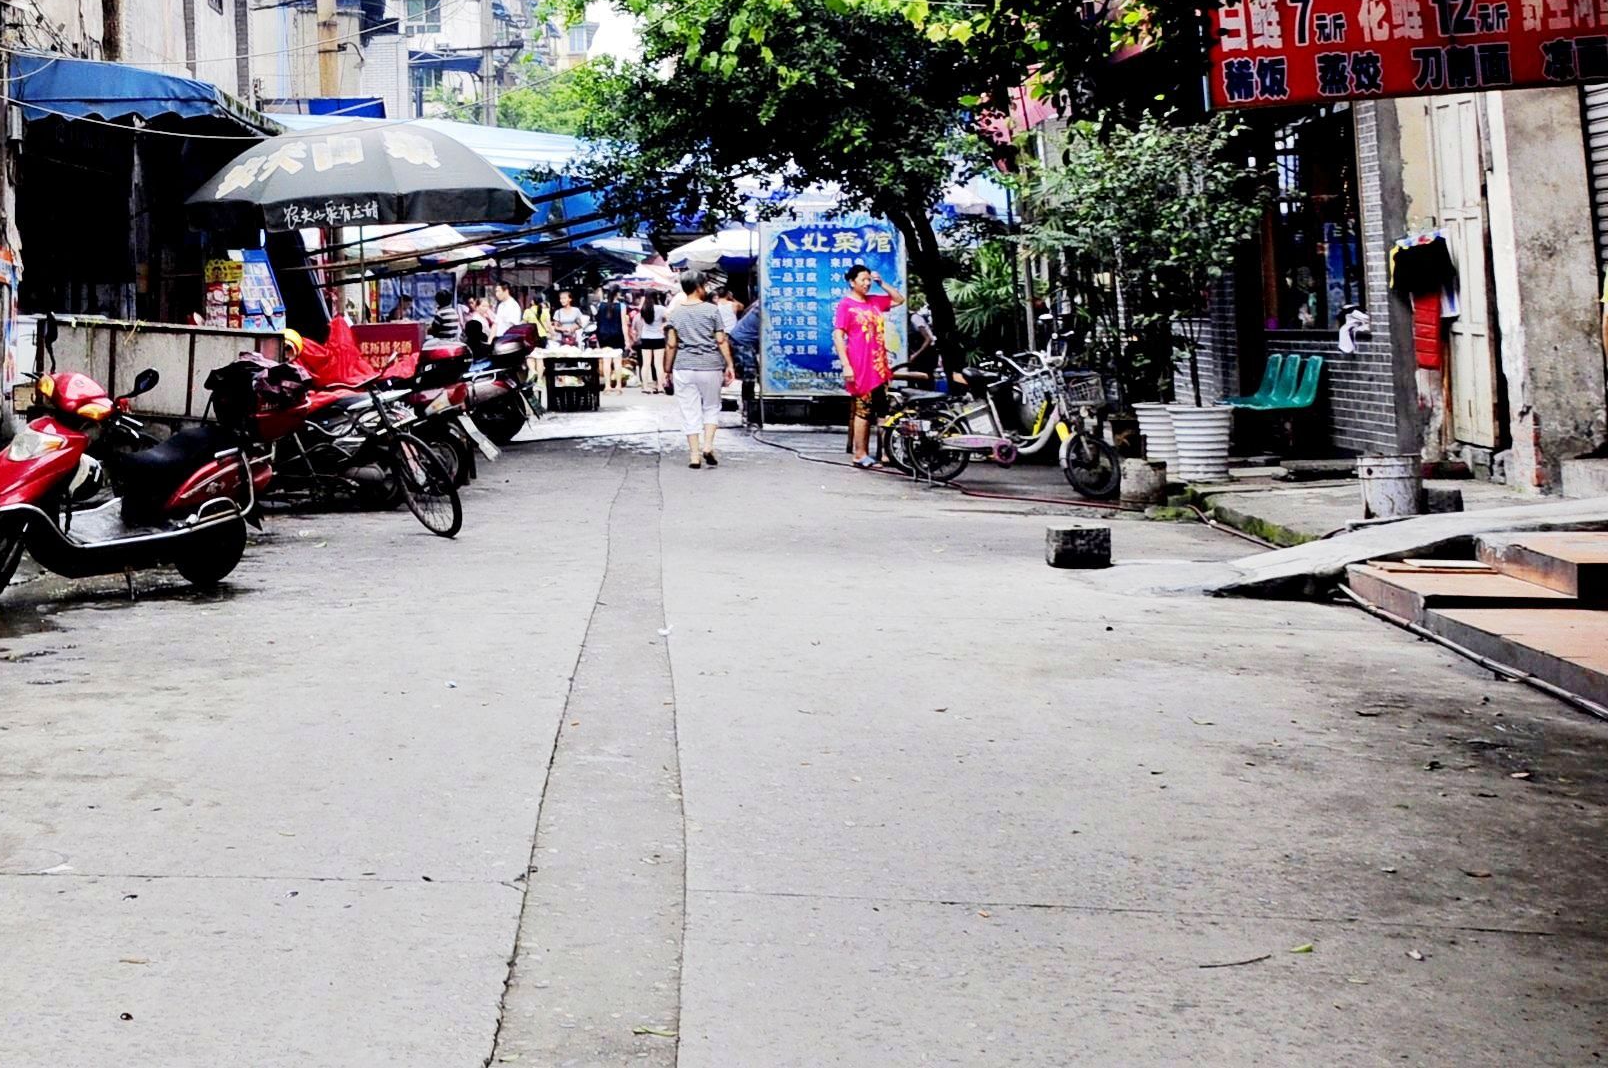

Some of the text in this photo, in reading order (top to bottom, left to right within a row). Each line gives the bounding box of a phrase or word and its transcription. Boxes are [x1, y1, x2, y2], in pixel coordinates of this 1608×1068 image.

[1222, 53, 1290, 102] 稀饭
[1316, 50, 1384, 96] 蒸饺
[283, 200, 379, 230] 农夫山泉有点甜
